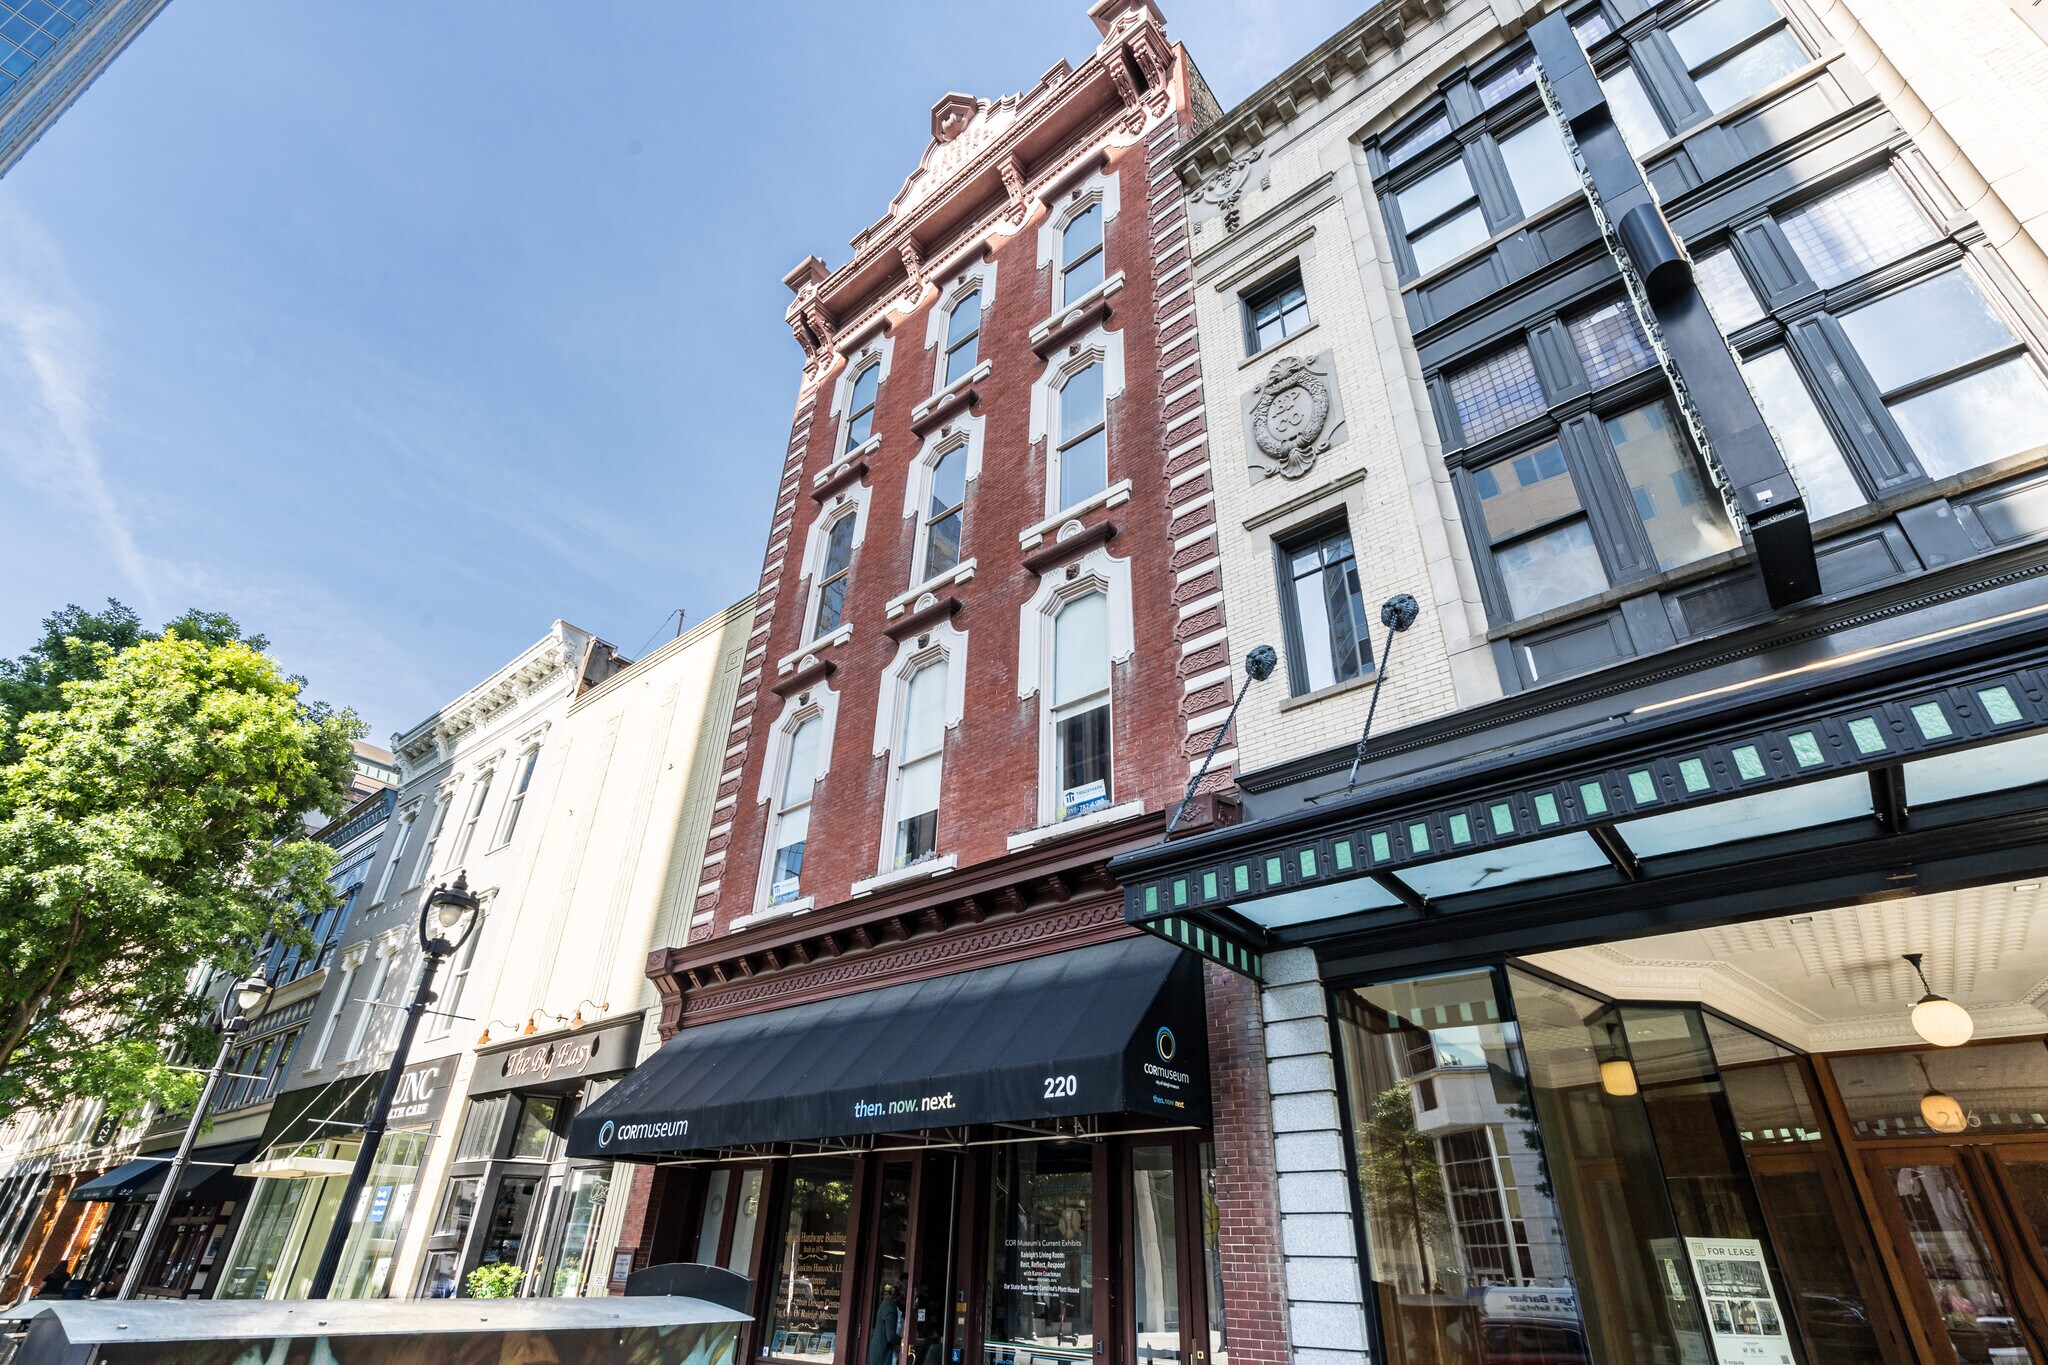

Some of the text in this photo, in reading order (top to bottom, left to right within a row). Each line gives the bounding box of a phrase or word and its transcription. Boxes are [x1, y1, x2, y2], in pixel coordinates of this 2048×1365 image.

[507, 1042, 591, 1080] The Big Easy
[1143, 1063, 1190, 1084] CORmuseum
[391, 1068, 440, 1105] UNC
[1043, 1074, 1077, 1099] 220
[406, 1103, 430, 1117] CARE
[854, 1091, 956, 1118] then. now. next.
[1937, 1109, 1981, 1128] 216
[617, 1119, 689, 1140] CORmuseum
[801, 1231, 824, 1243] Hardware
[825, 1231, 847, 1246] Building
[1004, 1239, 1082, 1247] COR Museum's Current Exhibits
[1020, 1251, 1039, 1260] Raleigh's
[1039, 1251, 1052, 1260] Living
[1707, 1247, 1726, 1256] FOR
[1727, 1247, 1757, 1257] LEASE
[1047, 1261, 1066, 1269] Respond
